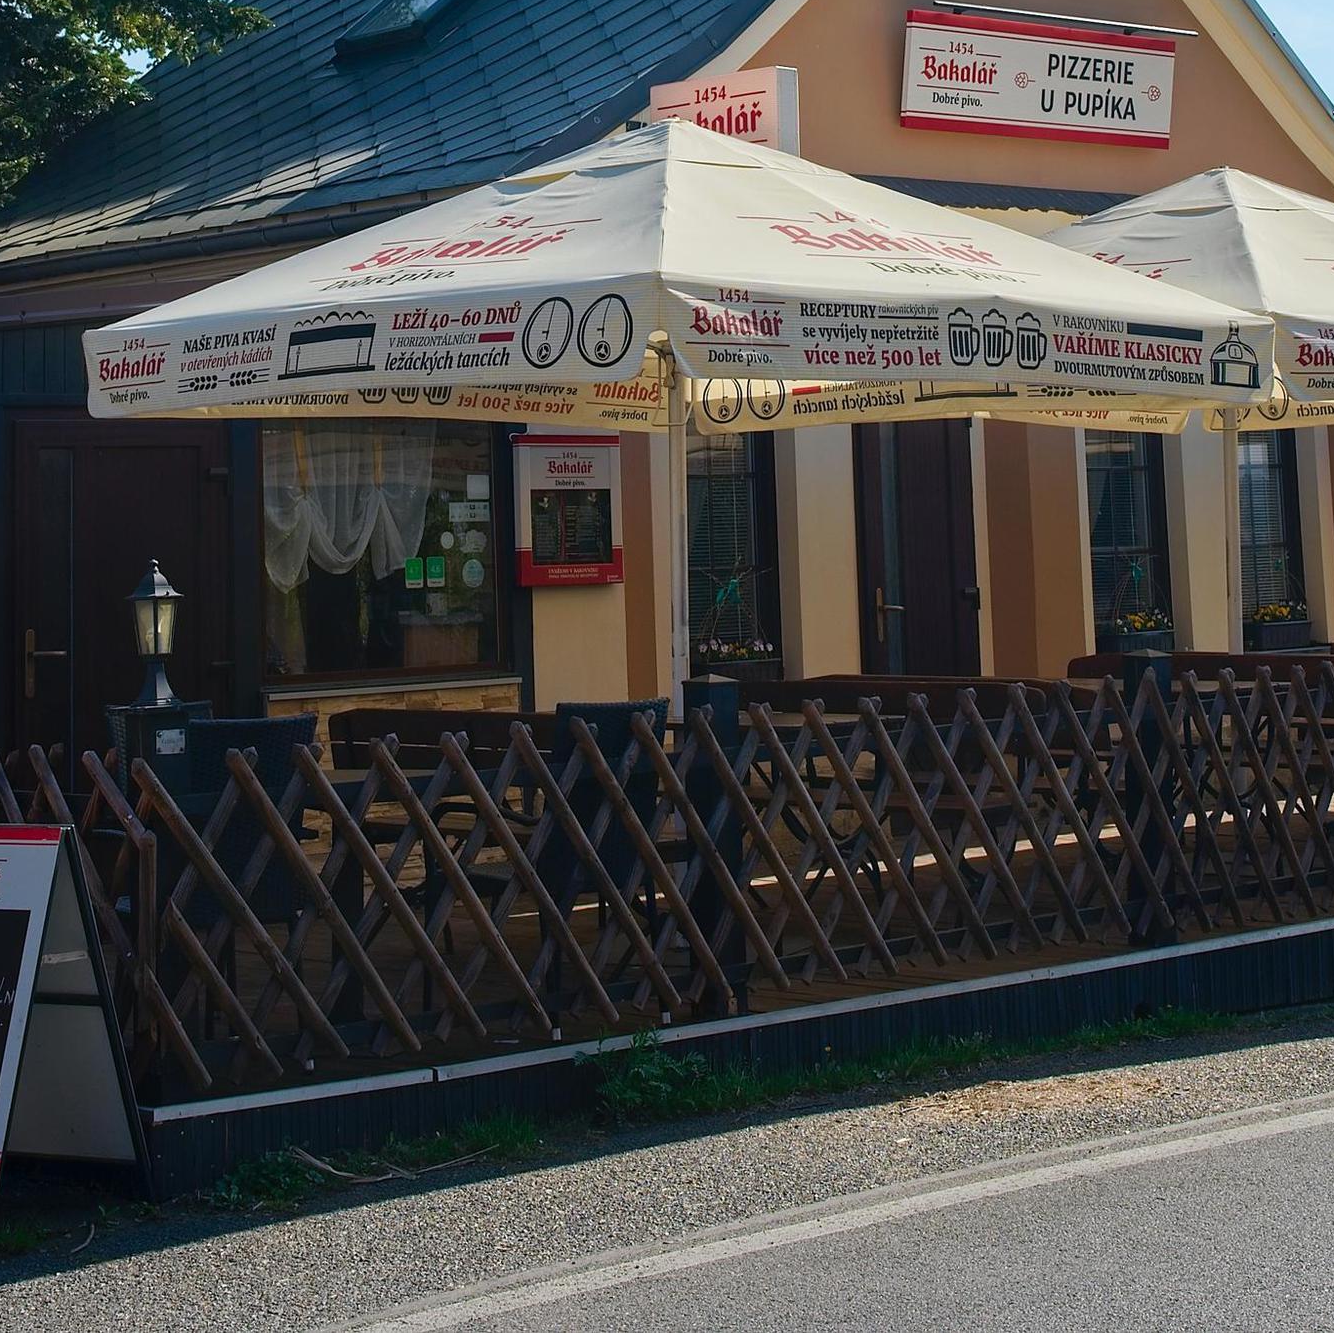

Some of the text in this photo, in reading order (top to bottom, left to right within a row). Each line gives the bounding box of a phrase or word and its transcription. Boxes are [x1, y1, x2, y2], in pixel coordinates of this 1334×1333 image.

[949, 41, 974, 55] 1454
[921, 55, 997, 85] Bakalář
[1047, 53, 1134, 85] PIZZERIE
[694, 85, 727, 104] 1454
[932, 92, 983, 108] Dobré pivo.
[1041, 88, 1136, 121] U PUPÍKA
[718, 288, 750, 303] 1454
[392, 308, 427, 331] LEŽÍ
[484, 300, 522, 326] DNŮ
[689, 305, 784, 337] Bakalář
[800, 302, 876, 319] RECEPTURY
[803, 323, 939, 343] se vyvíjely nepřetržitě
[1053, 315, 1124, 334] V RAKOVNÍKU
[122, 339, 145, 352] 1454
[182, 324, 277, 354] NAŠE PIVA KVASÍ
[388, 331, 477, 348] V HORIZONTÁLNÍCH
[1053, 332, 1203, 365] VAŘÍME KLASICKY
[99, 352, 166, 382] Bakalář
[180, 347, 273, 372] v otevřených kádích
[384, 347, 510, 376] ležáckých tancích
[708, 349, 773, 366] Dobré pivo.
[804, 343, 942, 370] více než 500 let
[1054, 360, 1205, 385] DVOURMUTOVÝM ZPŮSOBEM
[109, 390, 150, 405] Dobré pivo.
[547, 460, 593, 474] Bakalář
